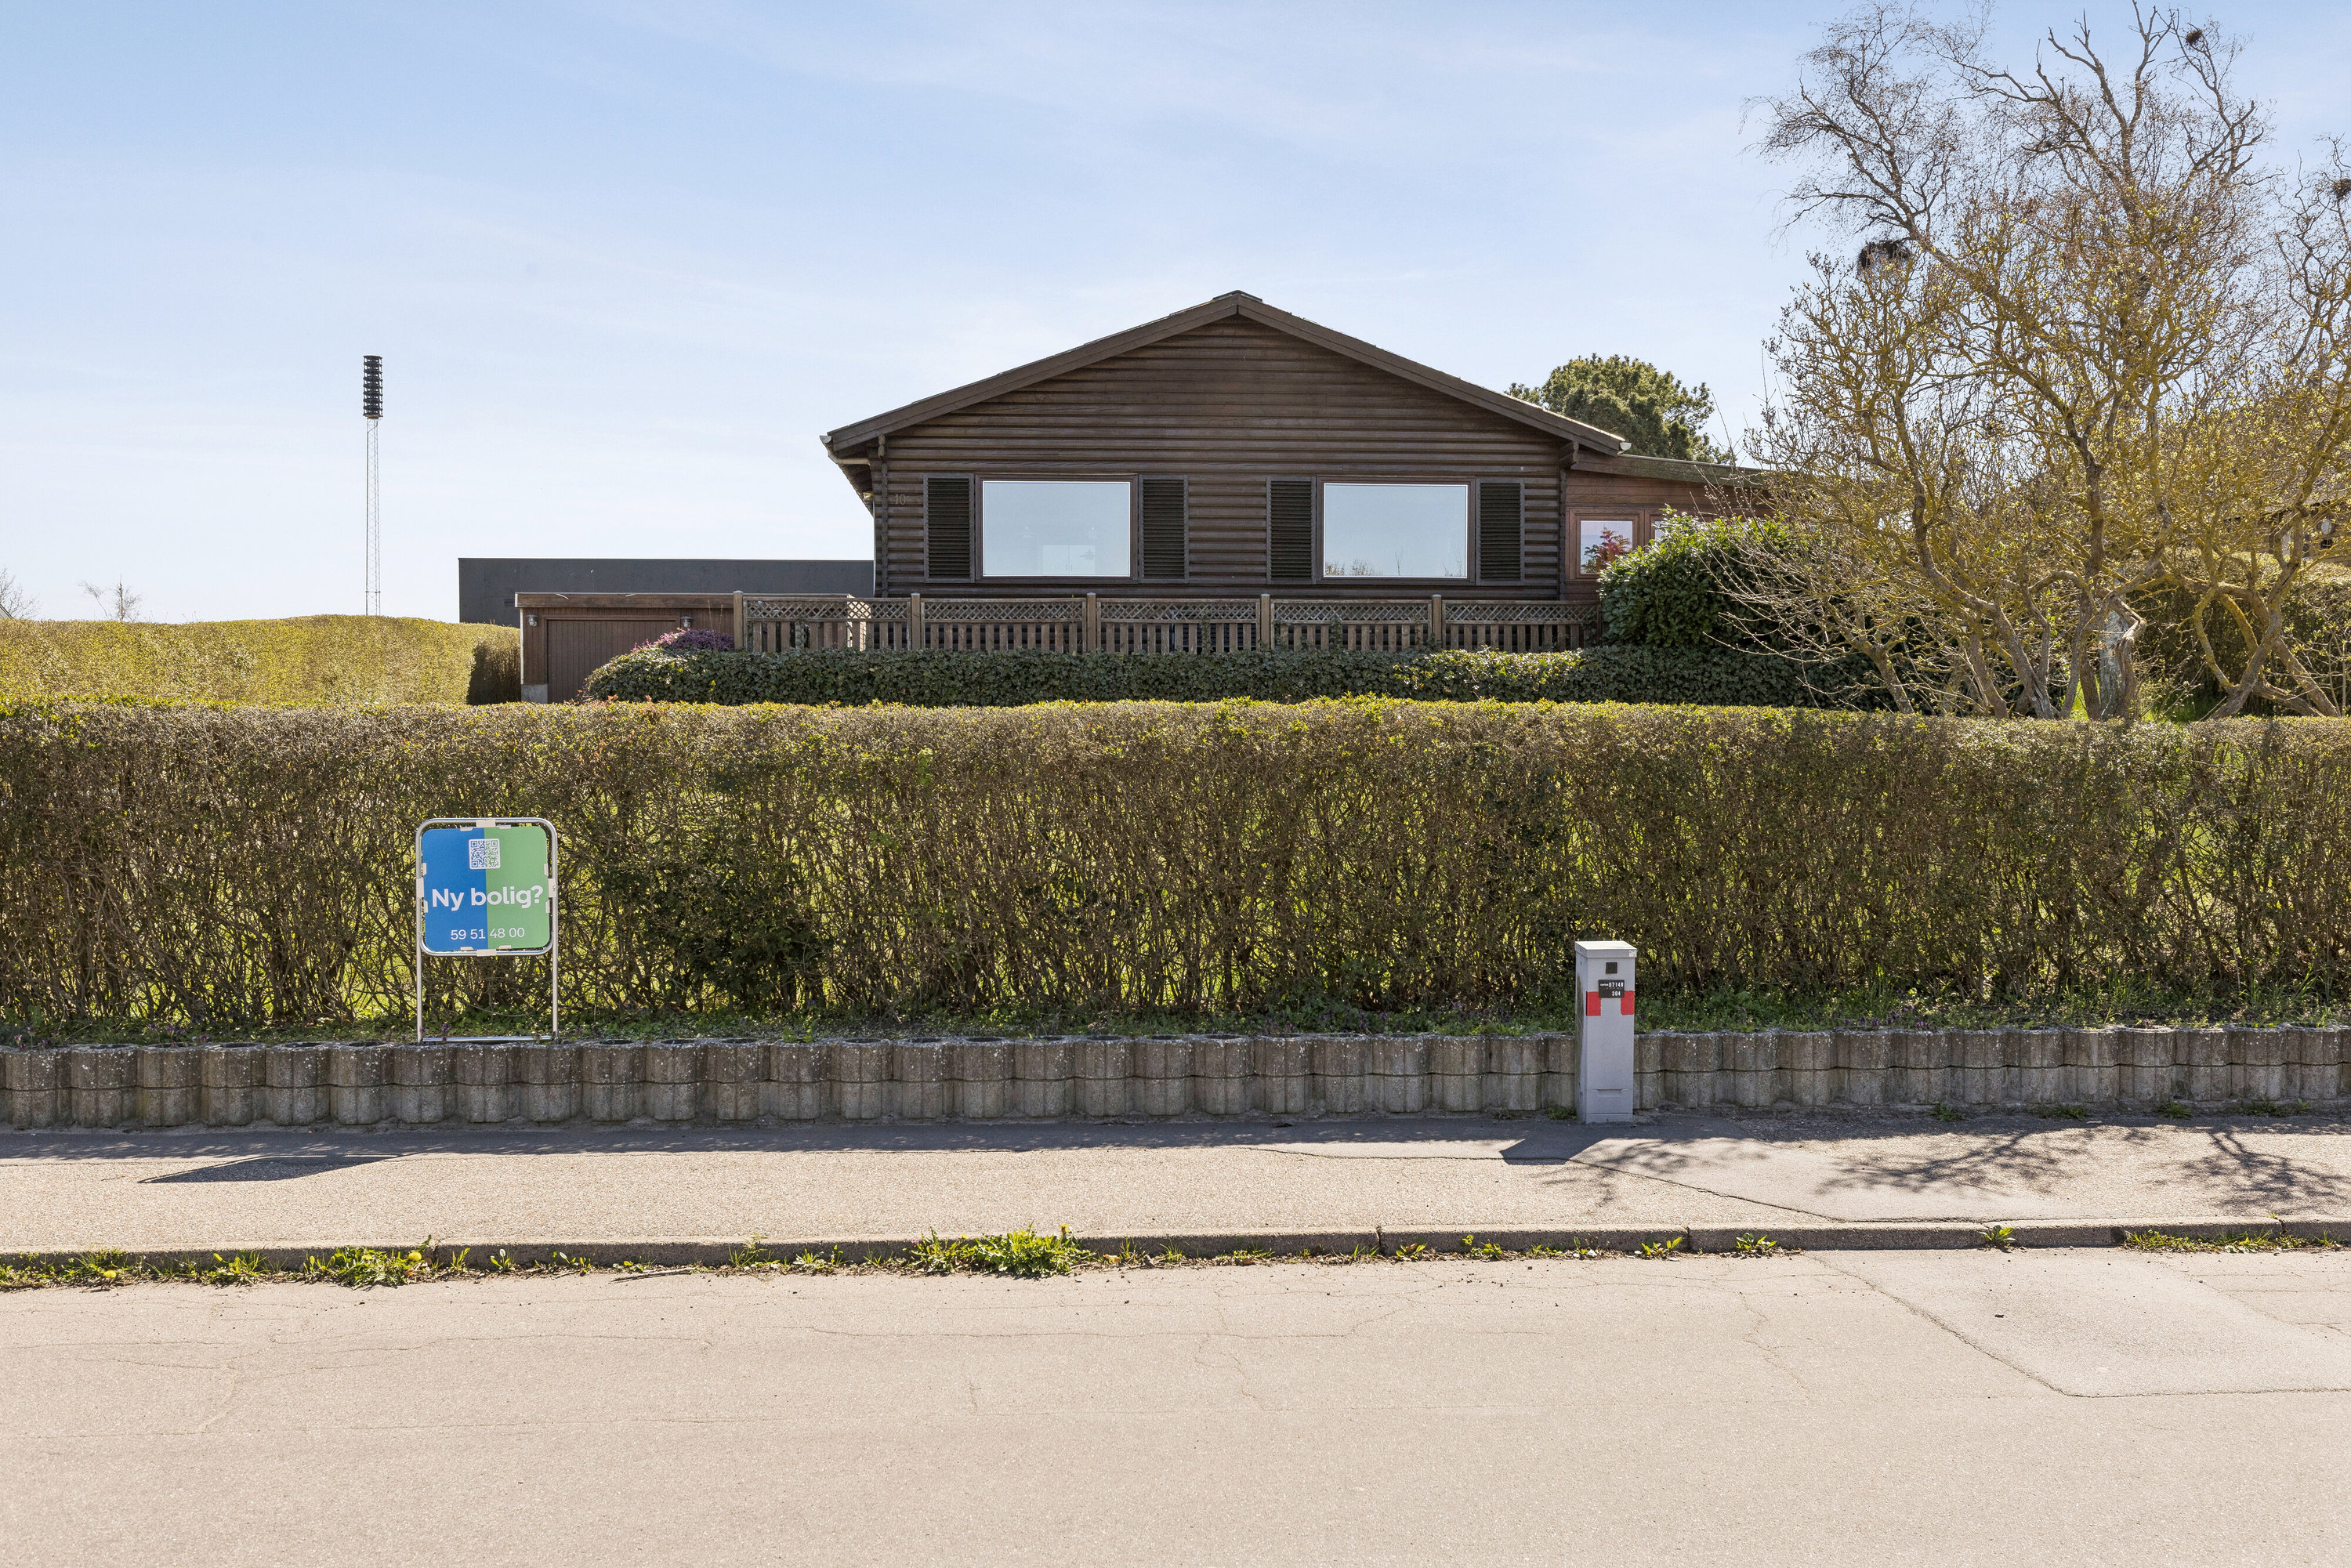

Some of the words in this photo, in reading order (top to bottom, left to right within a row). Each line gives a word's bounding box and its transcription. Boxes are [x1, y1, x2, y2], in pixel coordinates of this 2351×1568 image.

[894, 494, 906, 505] 10
[432, 888, 465, 911] Ny
[470, 885, 544, 909] bolig?
[451, 929, 467, 940] 59
[470, 929, 486, 940] 51
[490, 928, 505, 939] 48
[509, 927, 525, 938] 00
